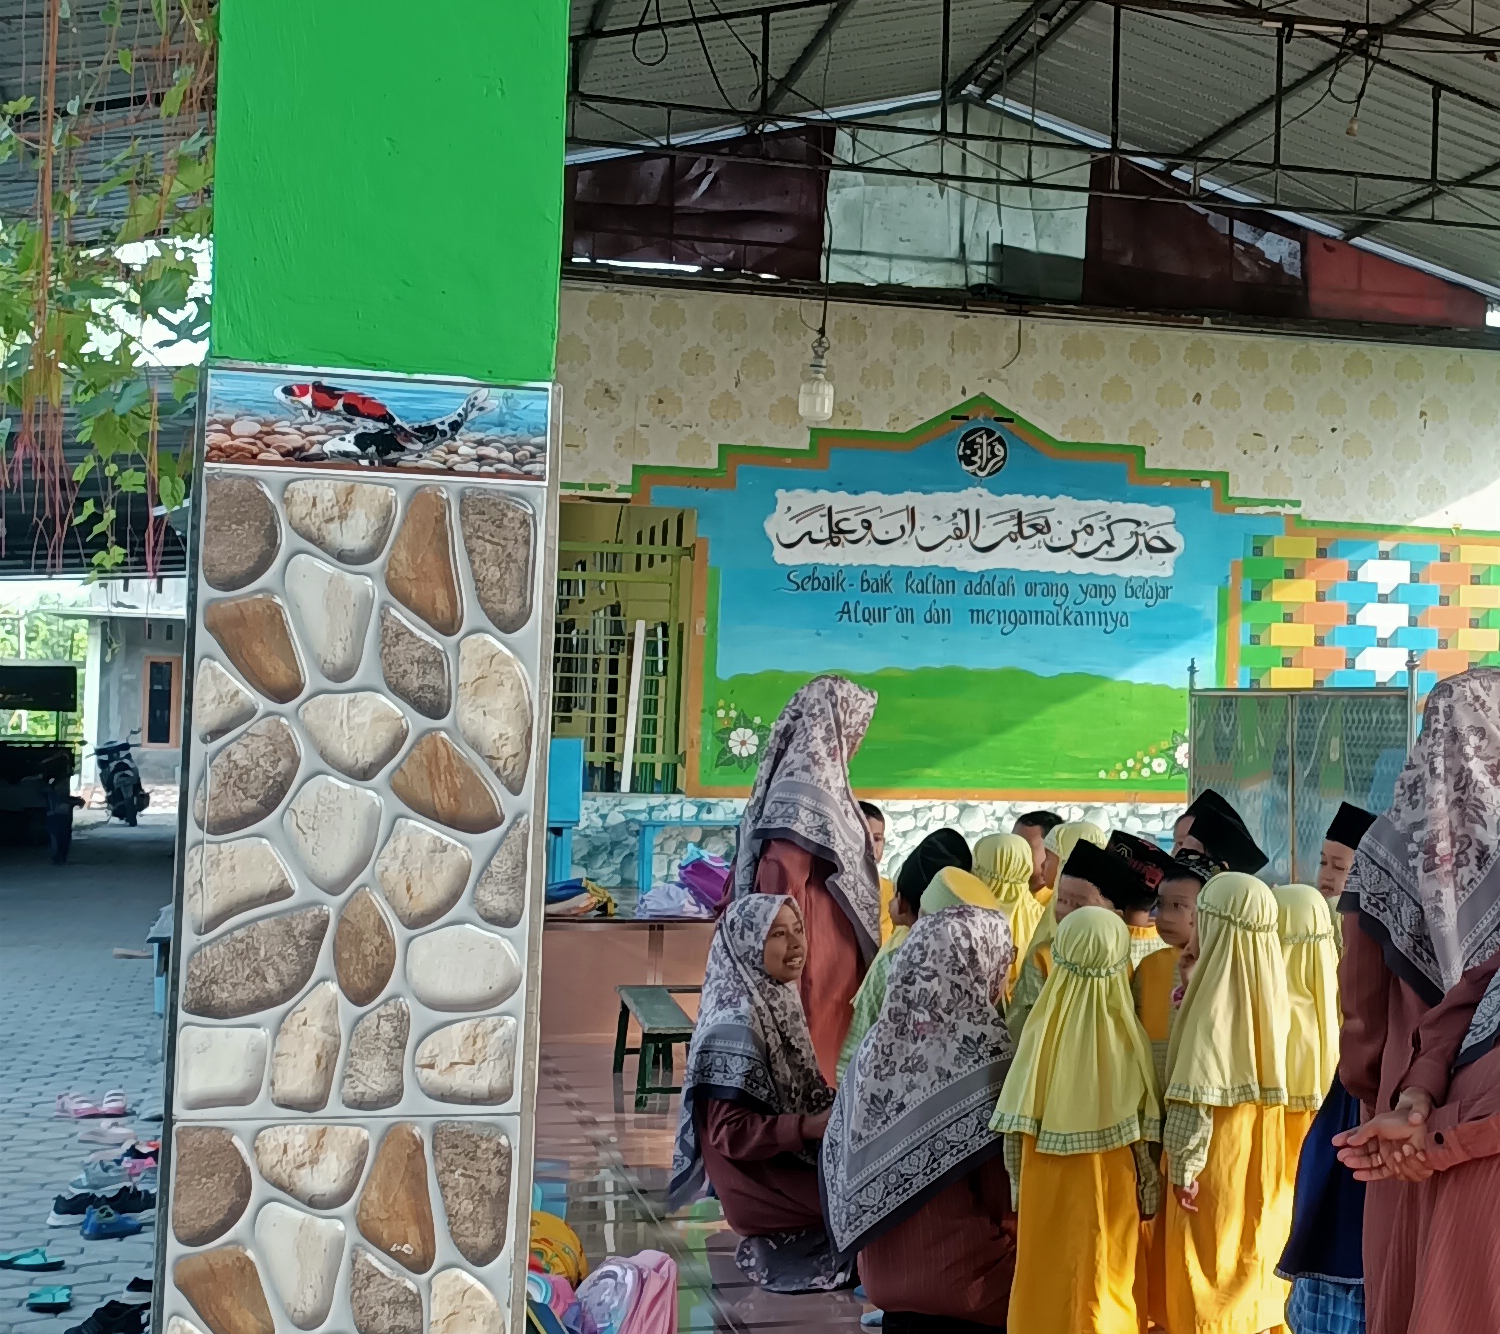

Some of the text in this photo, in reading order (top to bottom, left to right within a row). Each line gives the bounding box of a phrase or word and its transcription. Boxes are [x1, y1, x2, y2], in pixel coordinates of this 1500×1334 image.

[904, 570, 956, 595] kalian
[963, 573, 1016, 597] adalah
[1024, 581, 1070, 607] orang
[1073, 581, 1117, 607] yang
[1124, 577, 1174, 608] belajar
[923, 598, 951, 625] dan
[967, 606, 1130, 636] mengamalkannya
